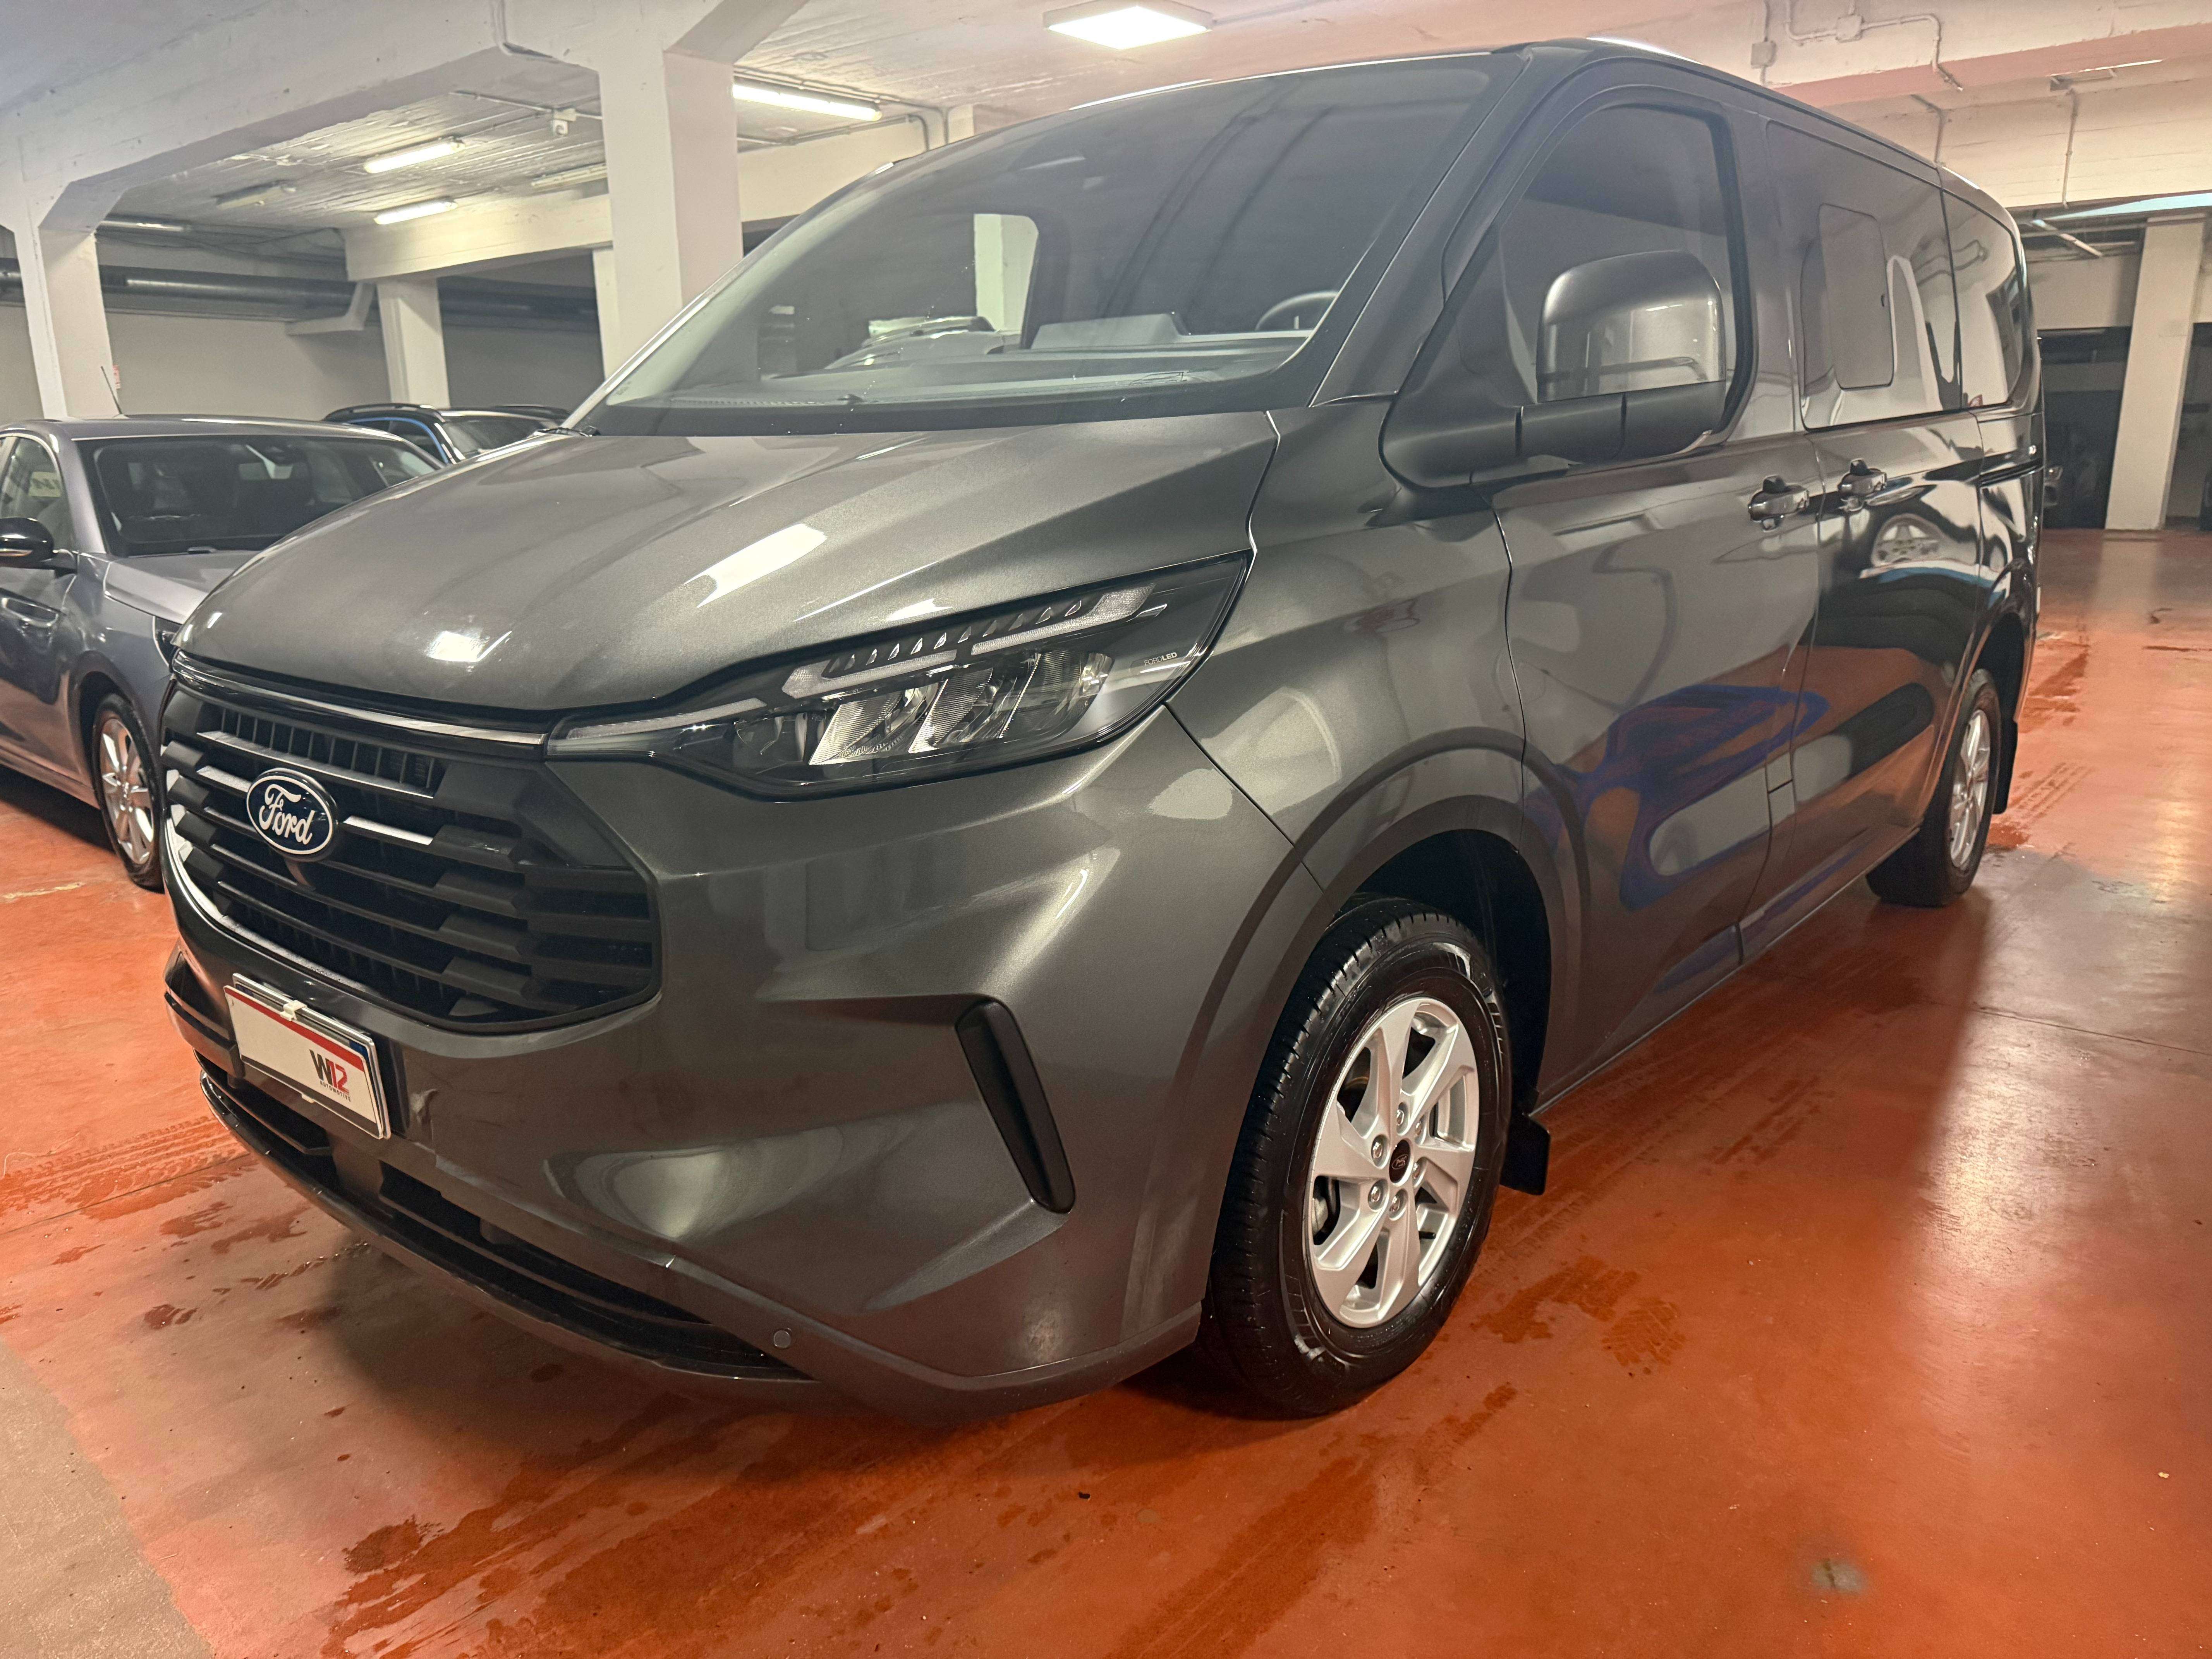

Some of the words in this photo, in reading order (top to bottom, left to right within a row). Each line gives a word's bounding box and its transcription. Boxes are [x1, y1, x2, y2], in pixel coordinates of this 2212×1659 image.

[1144, 652, 1177, 666] FORDLED
[259, 783, 316, 845] Ford
[309, 1049, 350, 1096] W12
[319, 1080, 351, 1102] AUTOMOTIVE
